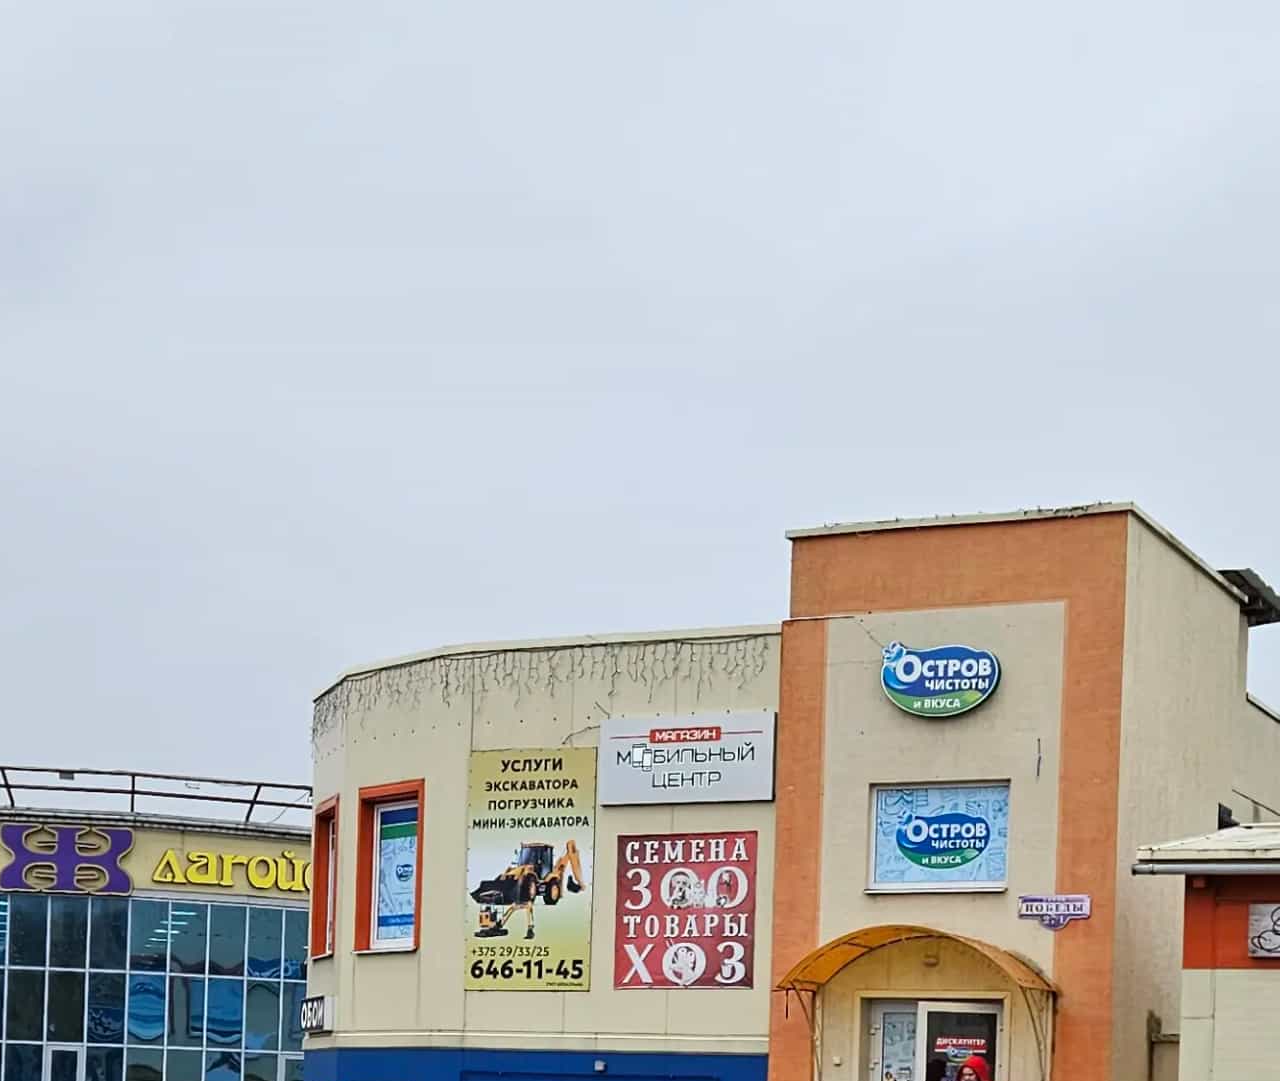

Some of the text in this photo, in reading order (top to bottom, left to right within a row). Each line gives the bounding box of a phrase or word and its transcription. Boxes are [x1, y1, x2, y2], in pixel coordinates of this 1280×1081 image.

[925, 679, 989, 690] ЧИСТОТЫ
[924, 698, 961, 708] ВКУСА
[655, 729, 717, 742] МАГАЗИН
[501, 758, 563, 772] УСЛУГИ
[485, 779, 579, 792] ЭКСКАВАТОРА
[651, 771, 722, 789] ЦЕНТР
[488, 797, 574, 811] ПОГРУЗЧИКА
[472, 816, 590, 829] МИНИ-ЭКСКАВАТОРА
[931, 839, 985, 849] ЧИСТОТЫ
[625, 838, 749, 864] СЕМЕНА
[931, 856, 961, 864] ВКУСА
[624, 866, 748, 910] ЗОО
[623, 913, 749, 938] ТОВАРЫ
[472, 945, 550, 958] +375 29/33/25
[470, 959, 583, 979] 646-11-45
[622, 941, 746, 986] ХОЗ
